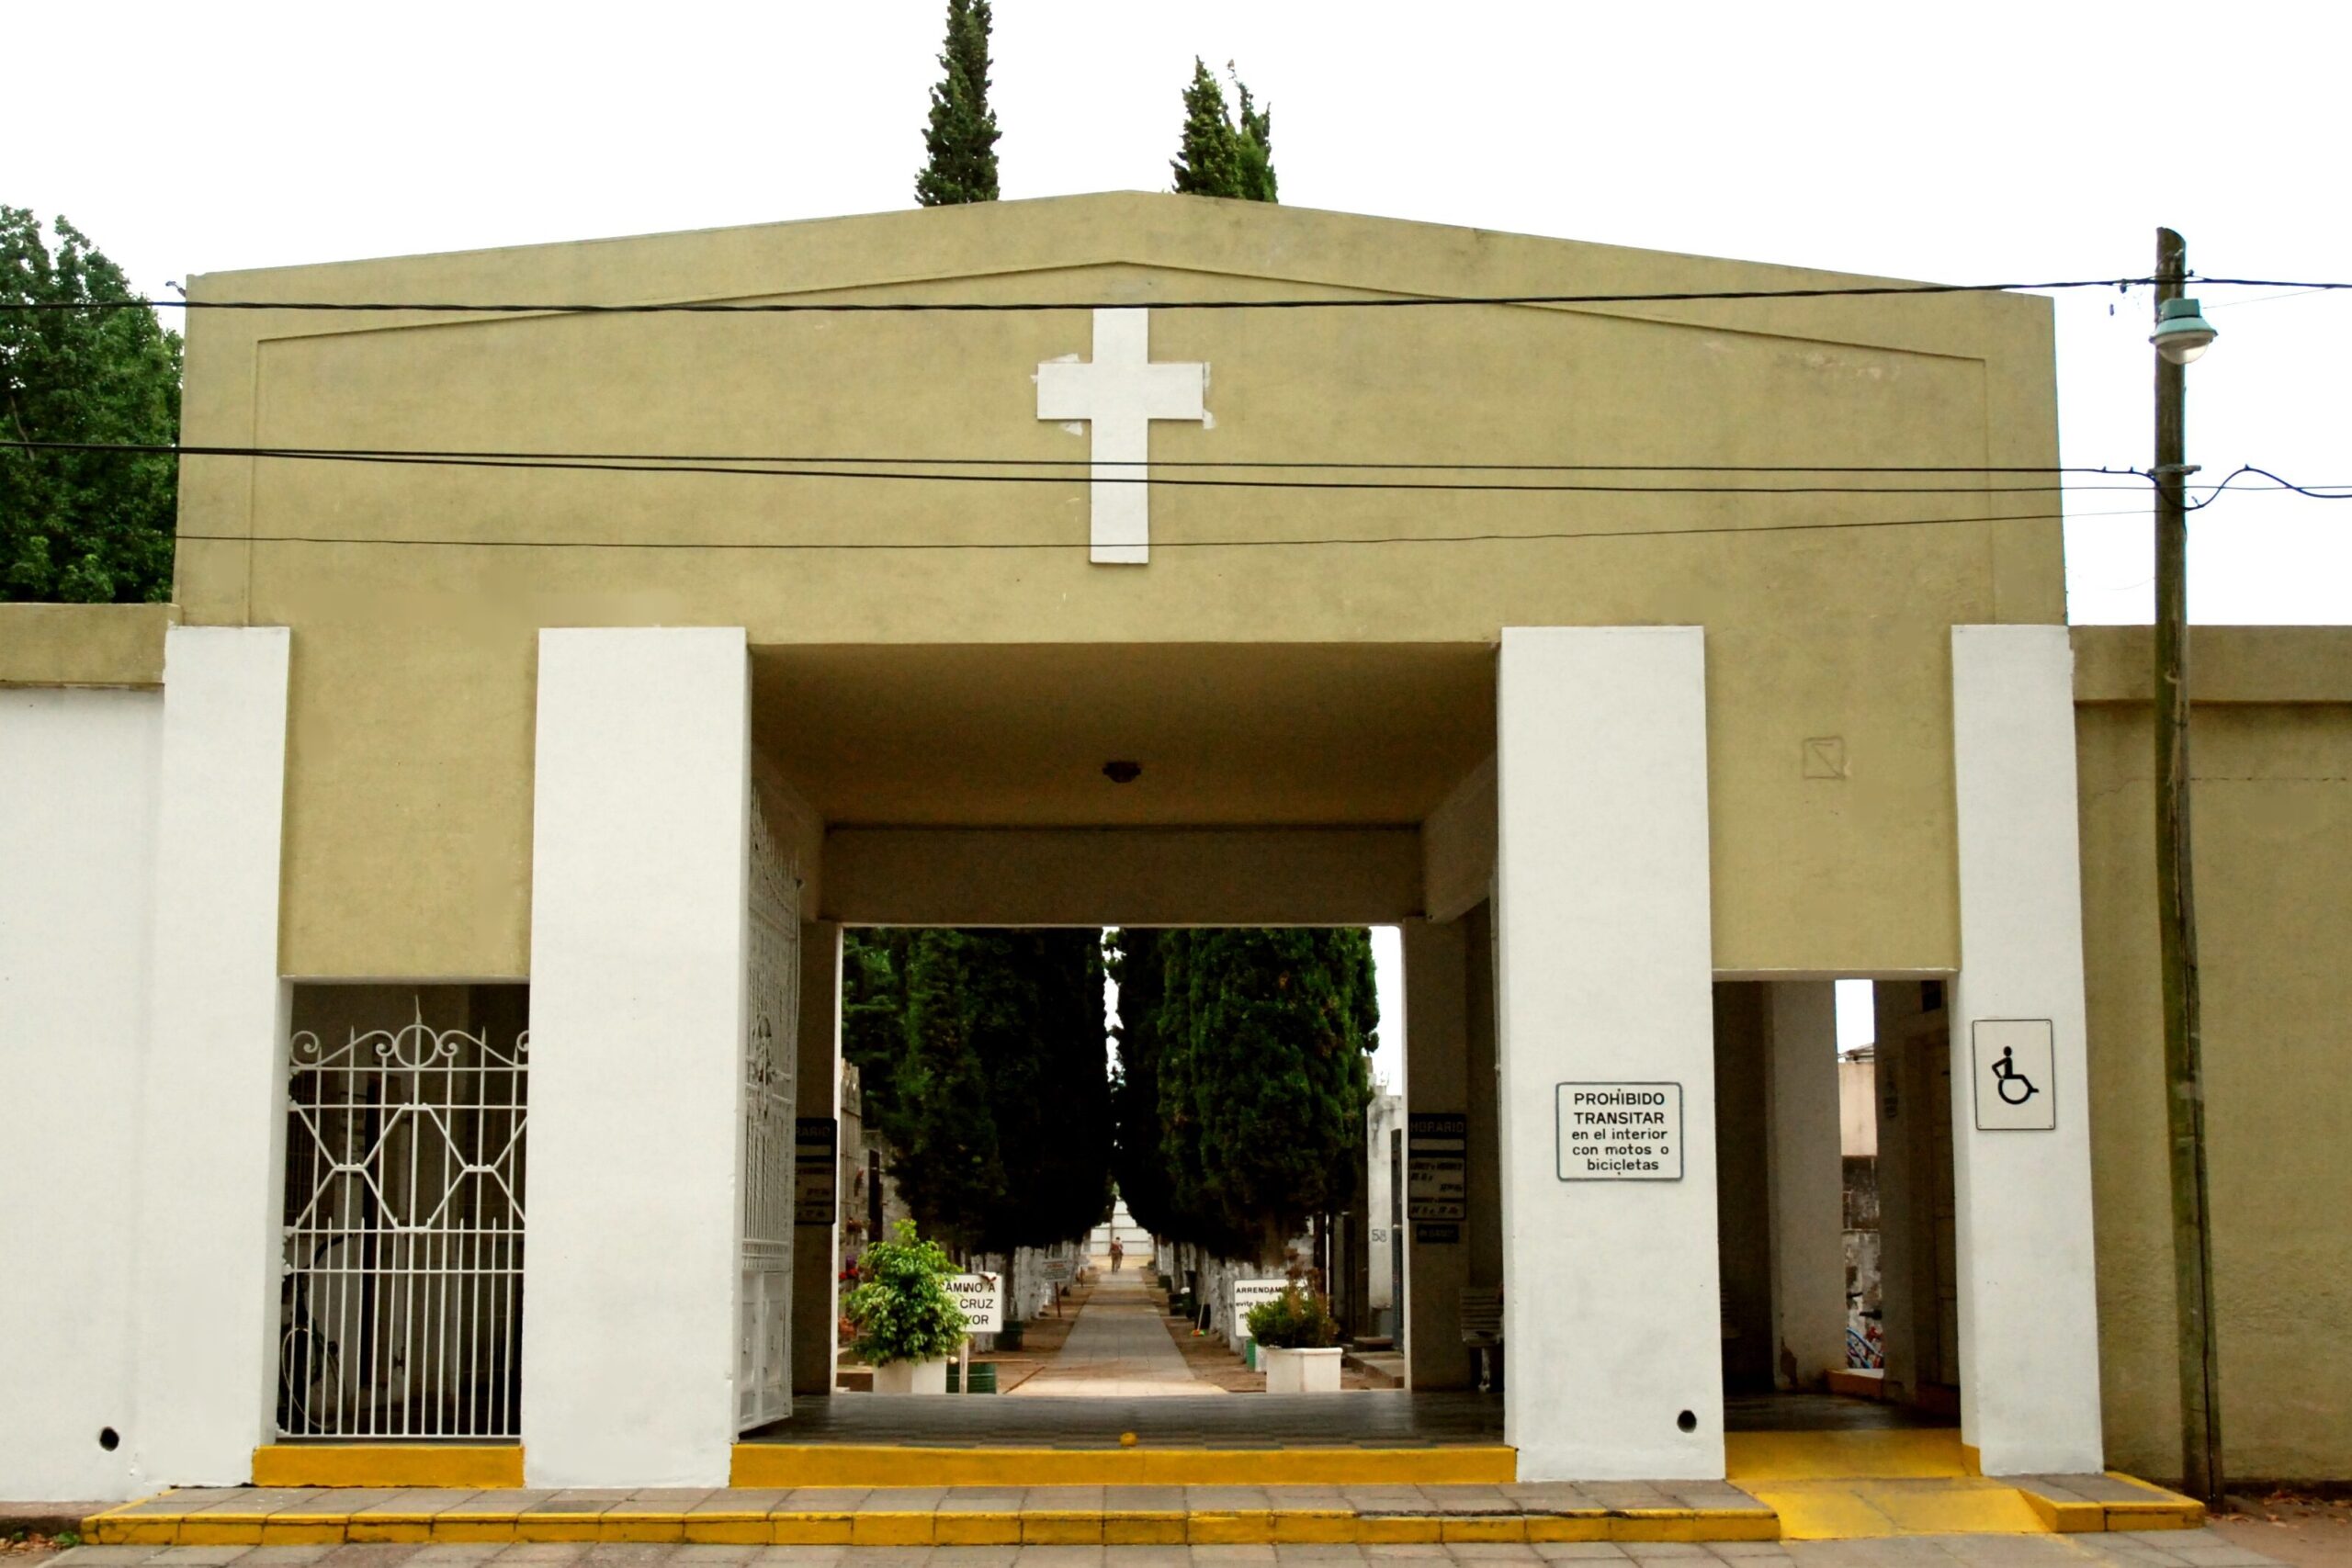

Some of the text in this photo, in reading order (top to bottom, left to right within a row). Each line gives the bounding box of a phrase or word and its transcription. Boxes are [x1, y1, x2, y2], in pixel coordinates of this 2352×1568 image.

[1574, 1092, 1665, 1106] PROHIBIDO
[1573, 1111, 1665, 1124] TRANSITAR
[1410, 1121, 1464, 1133] HORARIO
[1571, 1128, 1668, 1140] en el interior
[1572, 1144, 1669, 1156] con motos o
[1587, 1158, 1659, 1171] bicicletas
[1372, 1229, 1387, 1242] 58
[944, 1282, 996, 1292] AMINO A
[960, 1299, 993, 1309] CRUZ
